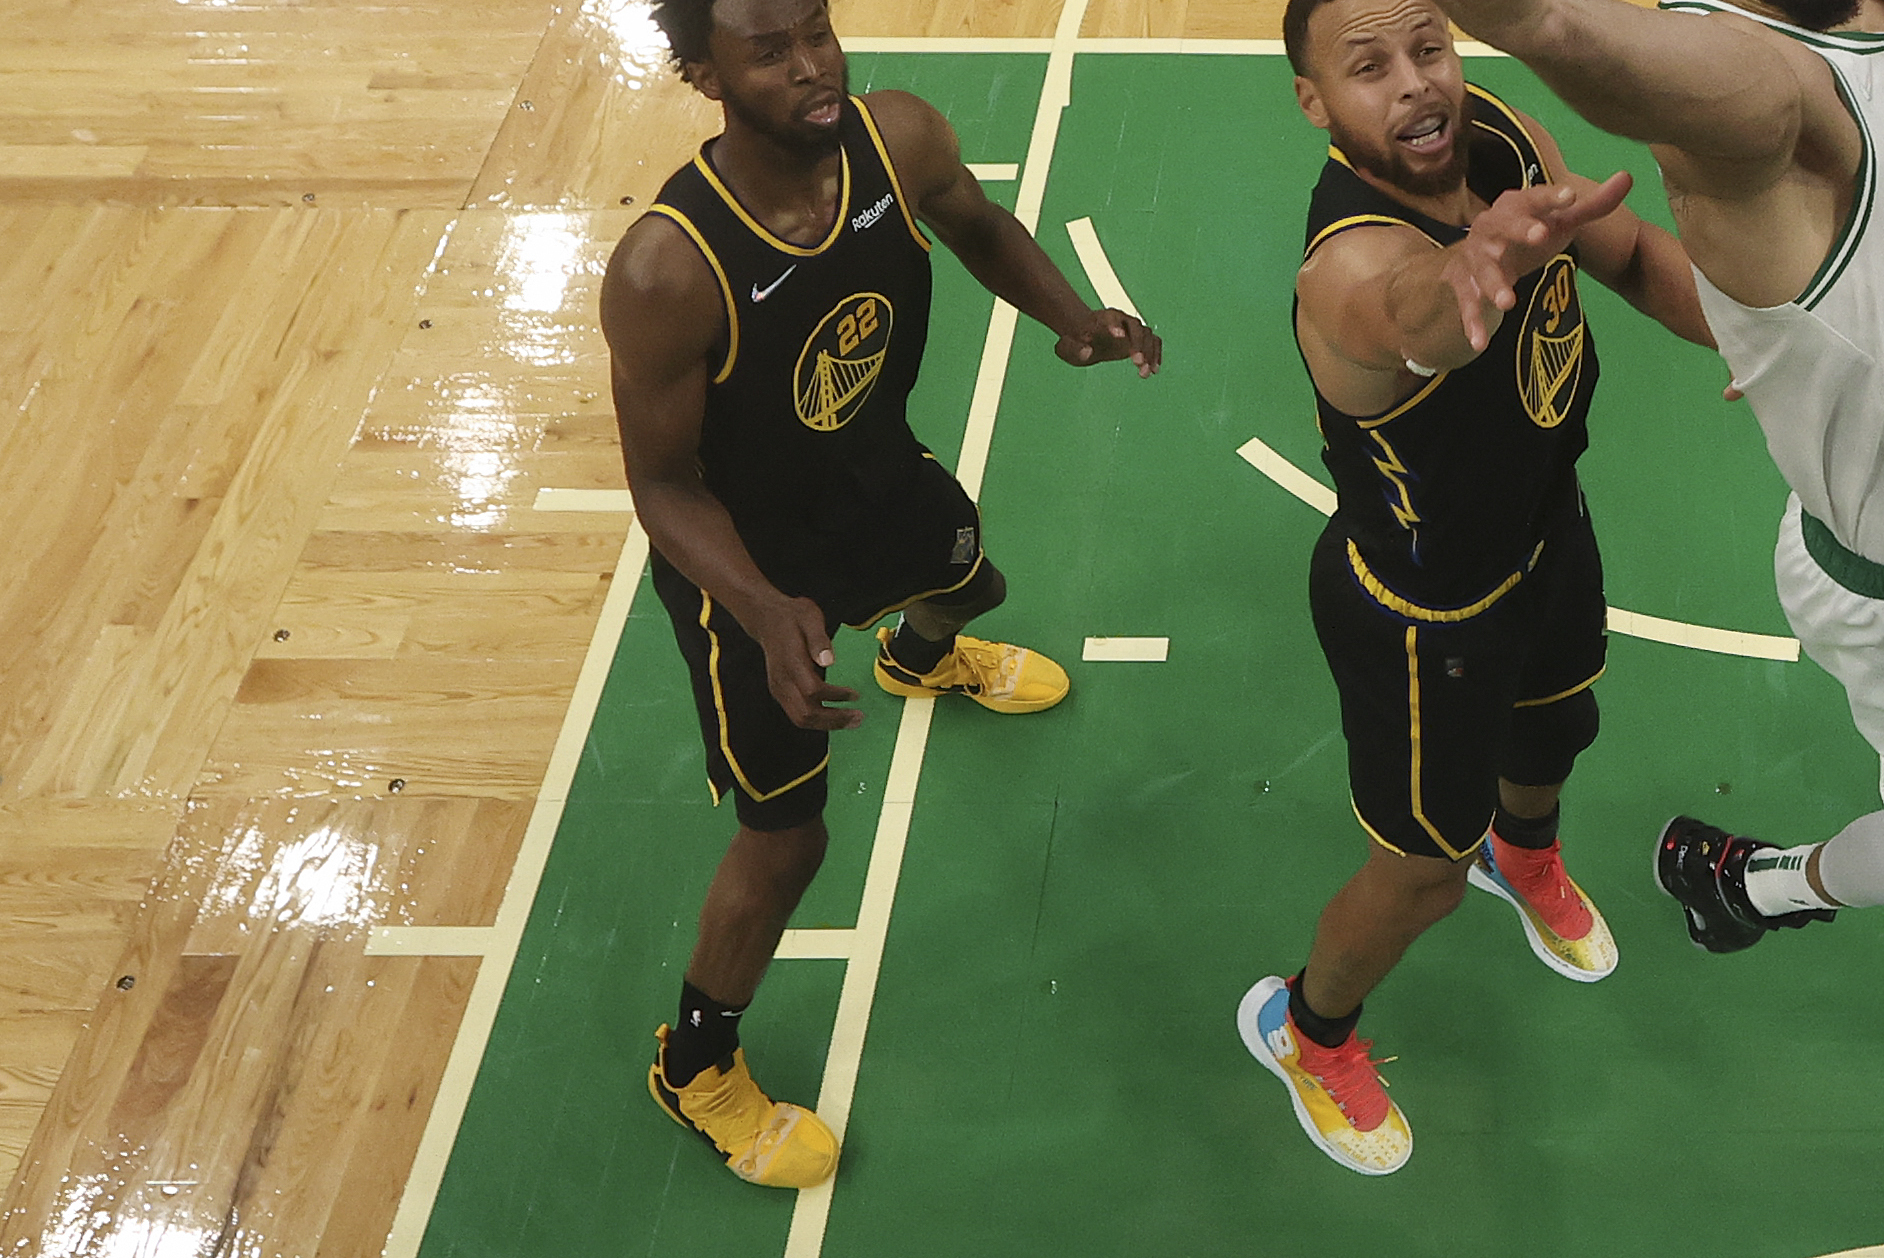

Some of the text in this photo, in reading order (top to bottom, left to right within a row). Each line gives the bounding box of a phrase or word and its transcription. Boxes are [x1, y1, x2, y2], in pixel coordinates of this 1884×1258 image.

[852, 193, 894, 232] Rakuten
[836, 298, 880, 357] 22
[1541, 263, 1570, 334] 30
